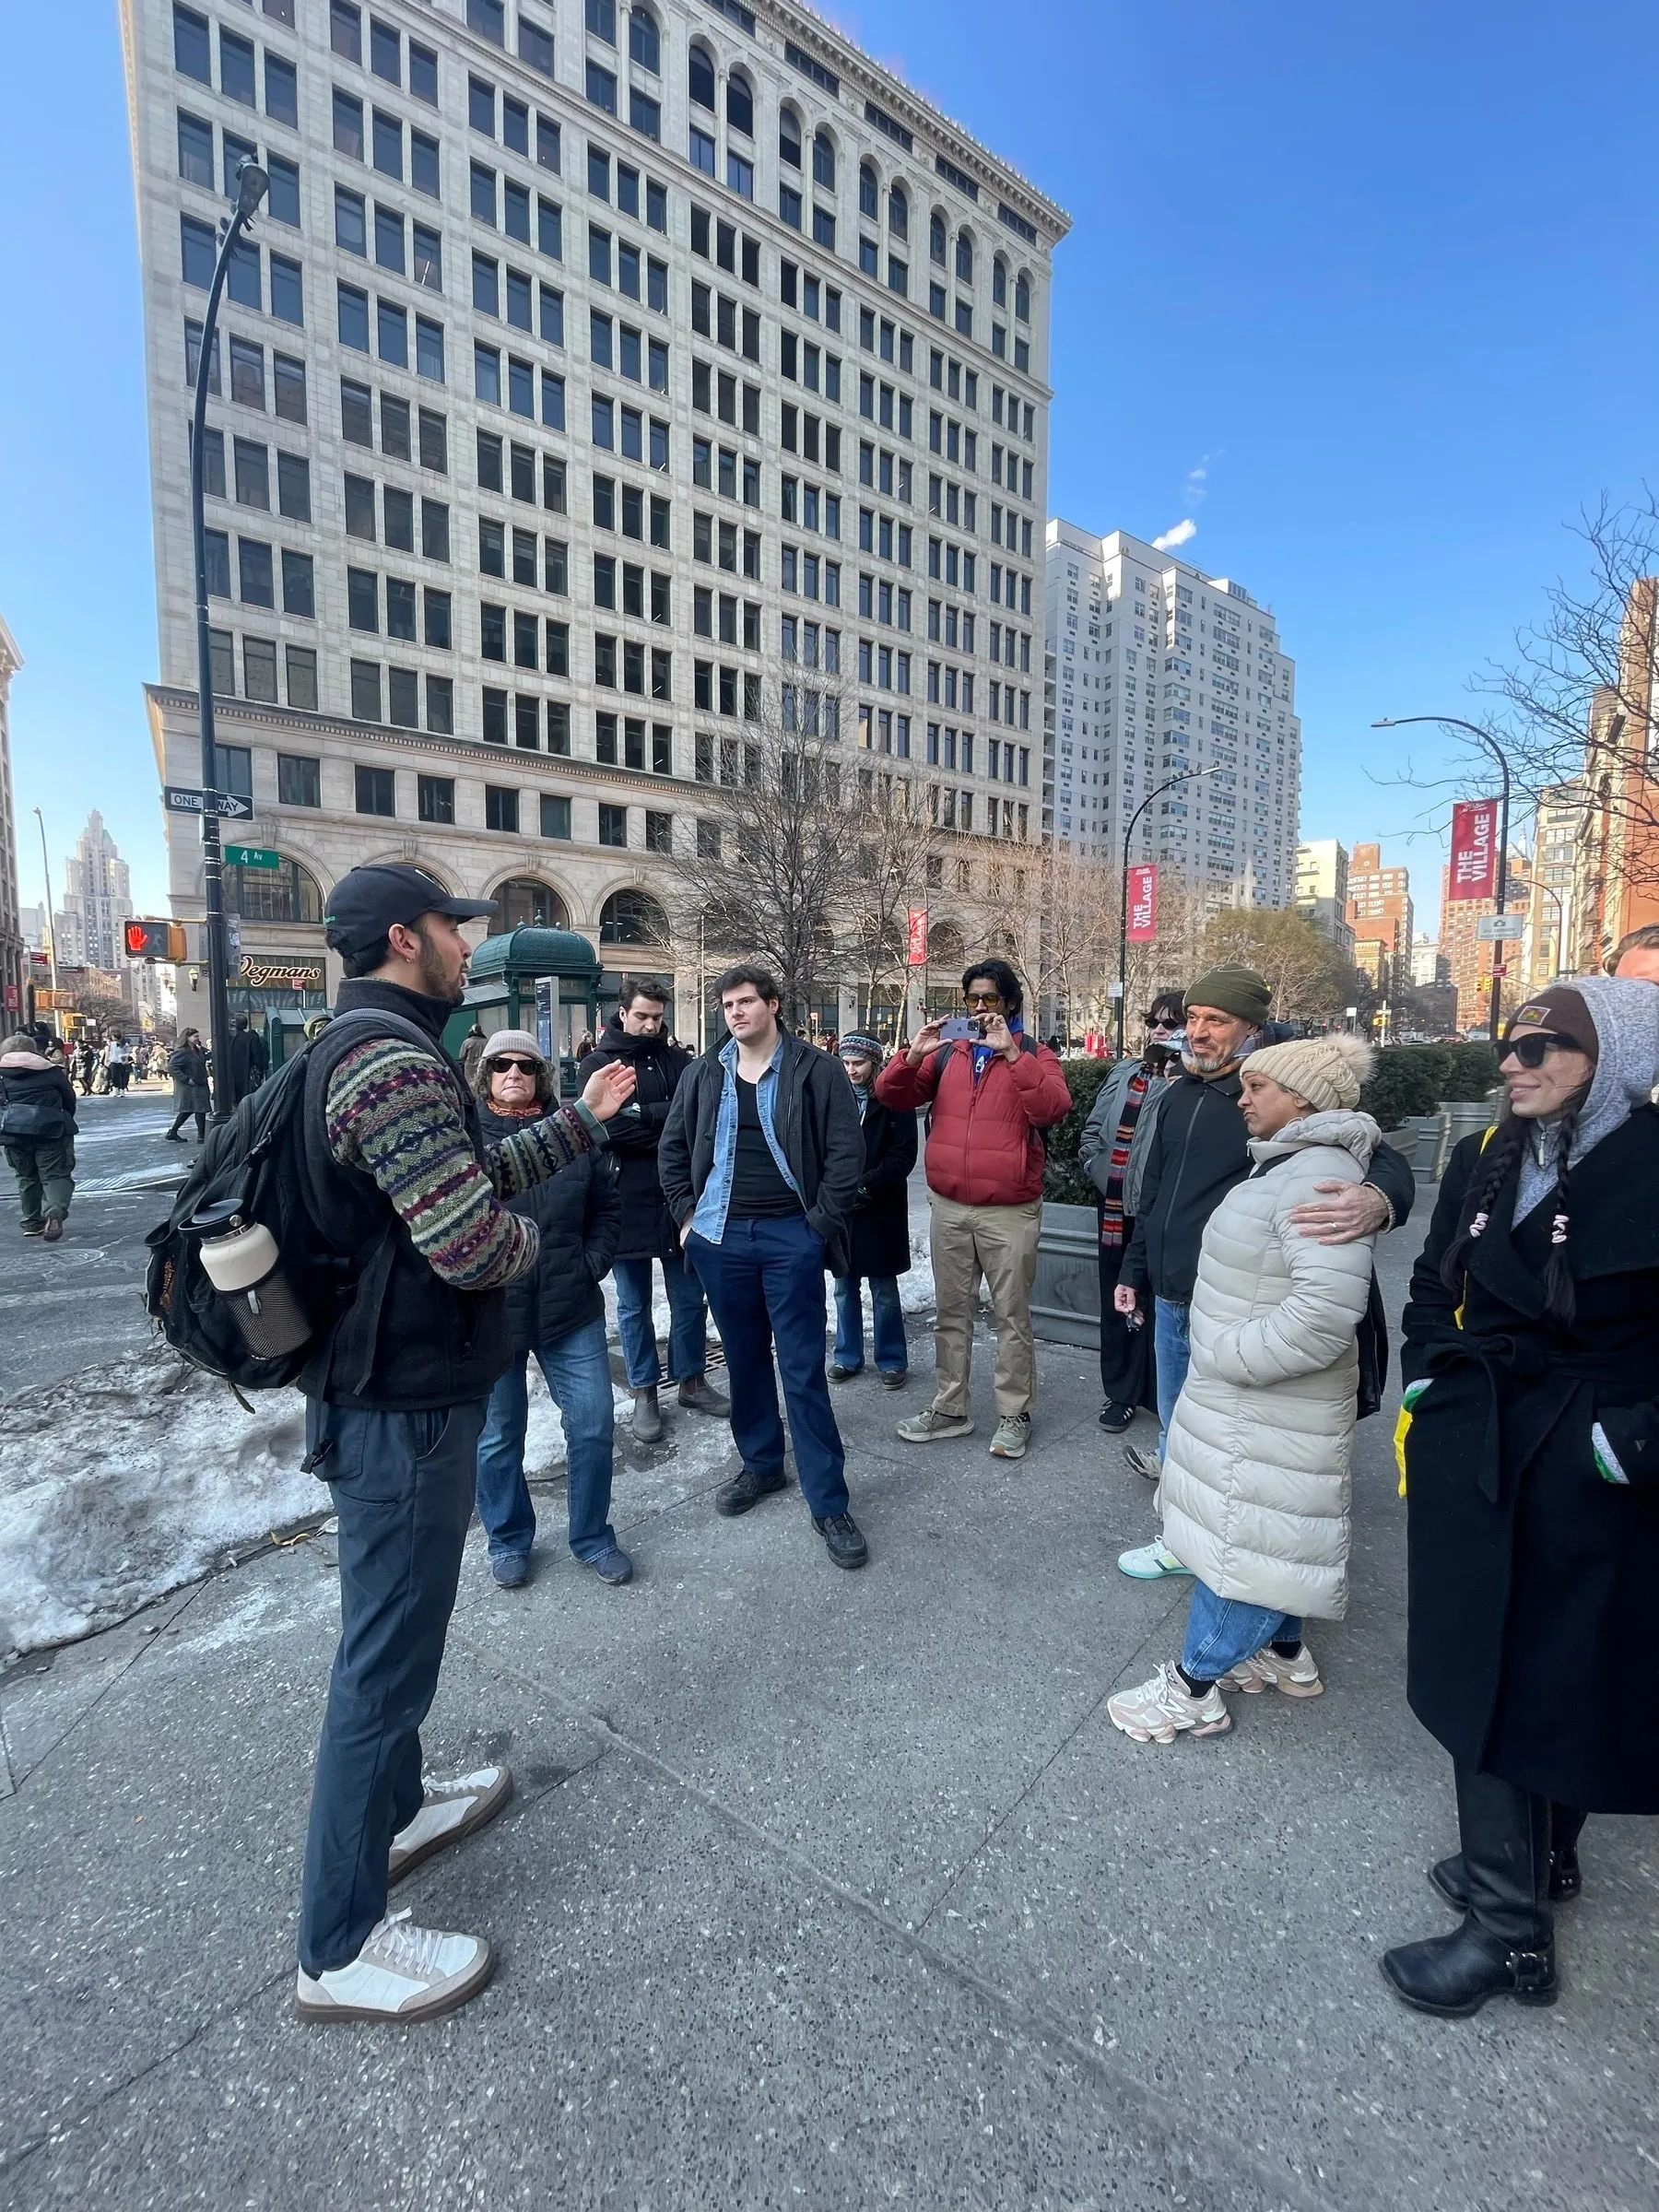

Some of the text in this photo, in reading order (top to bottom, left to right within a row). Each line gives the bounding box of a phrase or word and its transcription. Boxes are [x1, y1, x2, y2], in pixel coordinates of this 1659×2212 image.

[174, 794, 199, 806] ONE
[240, 850, 263, 865] 4 Av
[1472, 814, 1490, 882] VILLAGE
[1457, 851, 1473, 883] THE
[1133, 904, 1143, 929] THE
[1142, 877, 1152, 928] VILLAGE
